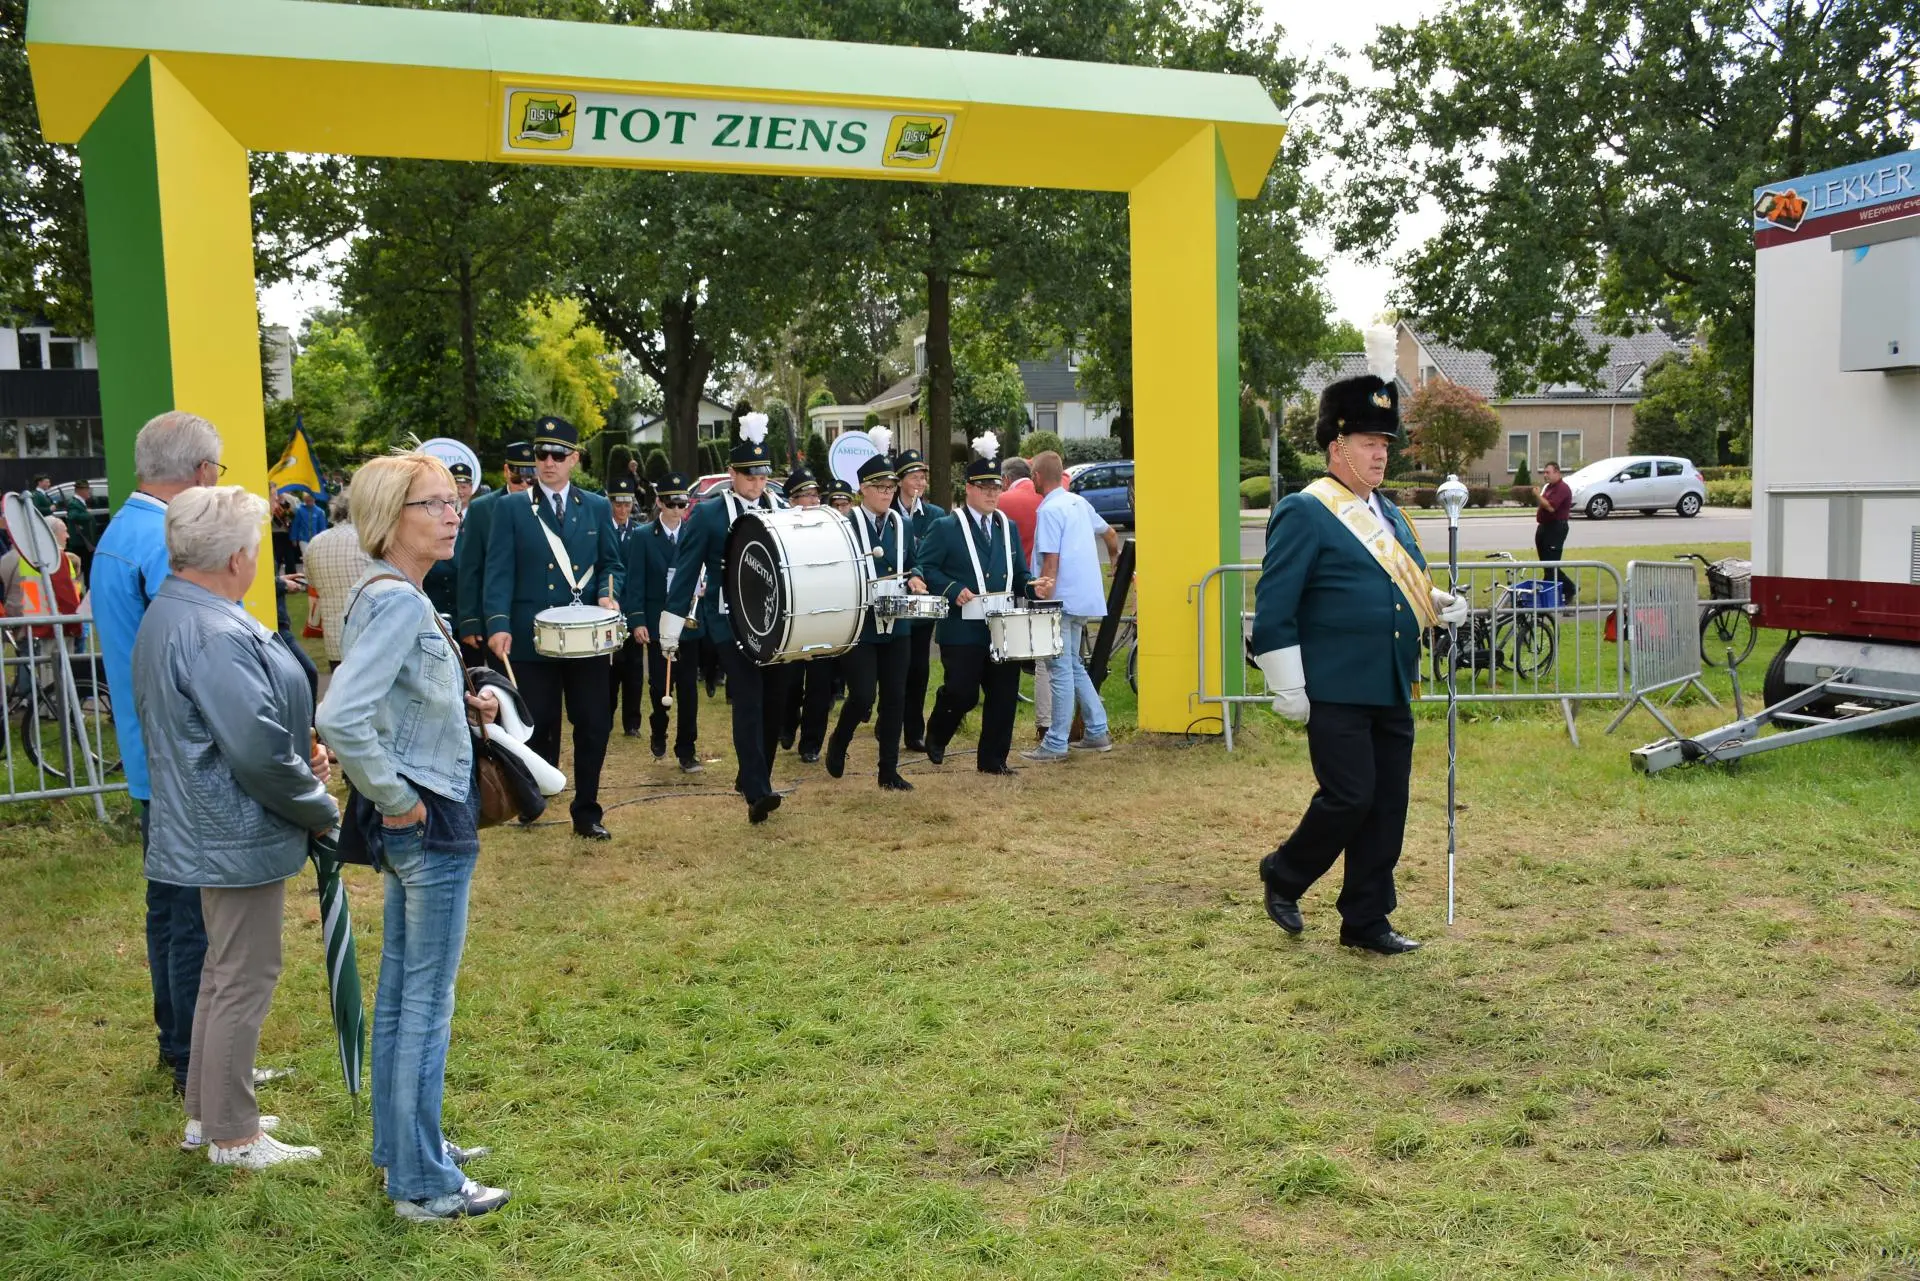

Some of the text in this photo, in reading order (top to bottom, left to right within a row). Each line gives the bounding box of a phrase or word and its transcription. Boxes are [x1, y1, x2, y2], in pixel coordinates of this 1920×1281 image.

[585, 106, 868, 154] TOT ZIENS
[1812, 163, 1916, 212] LEKKER
[837, 447, 876, 457] AMICITIA
[745, 552, 774, 586] AMICITIA
